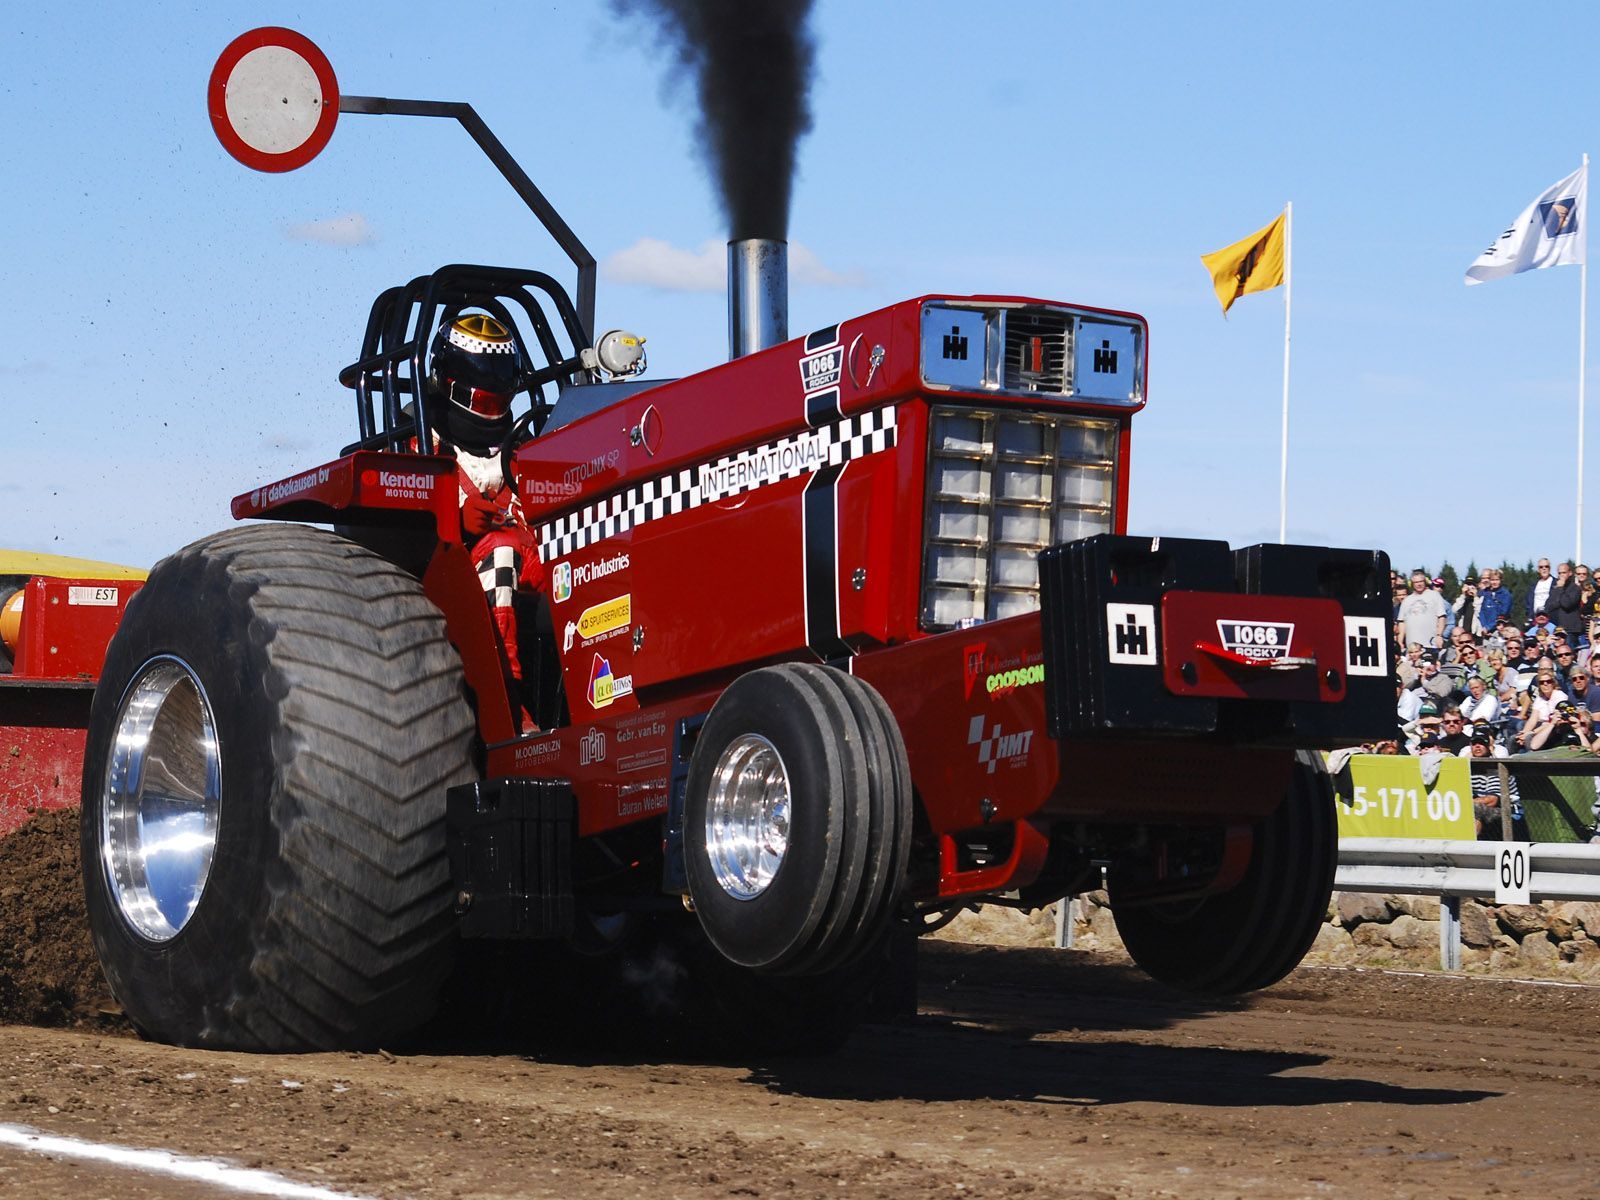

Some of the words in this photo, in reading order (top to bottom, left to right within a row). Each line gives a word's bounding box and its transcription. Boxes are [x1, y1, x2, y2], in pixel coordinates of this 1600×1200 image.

[808, 353, 835, 376] 1066
[810, 372, 835, 388] ROCKY
[702, 438, 825, 495] INTERNATIONAL
[269, 472, 317, 502] dabekausen
[319, 467, 331, 484] bv
[380, 471, 434, 489] Kendall
[385, 488, 415, 499] MOTOR
[416, 491, 430, 500] OIL
[574, 563, 591, 587] PPG
[592, 552, 630, 580] Industries
[95, 588, 117, 600] EST
[1234, 625, 1278, 645] 1066
[1235, 646, 1279, 659] ROCKY
[606, 678, 632, 697] COATINGS
[986, 664, 1044, 693] GOODSON
[617, 728, 637, 743] Gebr.
[638, 726, 651, 738] van
[653, 722, 666, 737] Erp
[996, 730, 1033, 759] HMT
[1426, 790, 1461, 822] 00
[1501, 849, 1524, 889] 60
